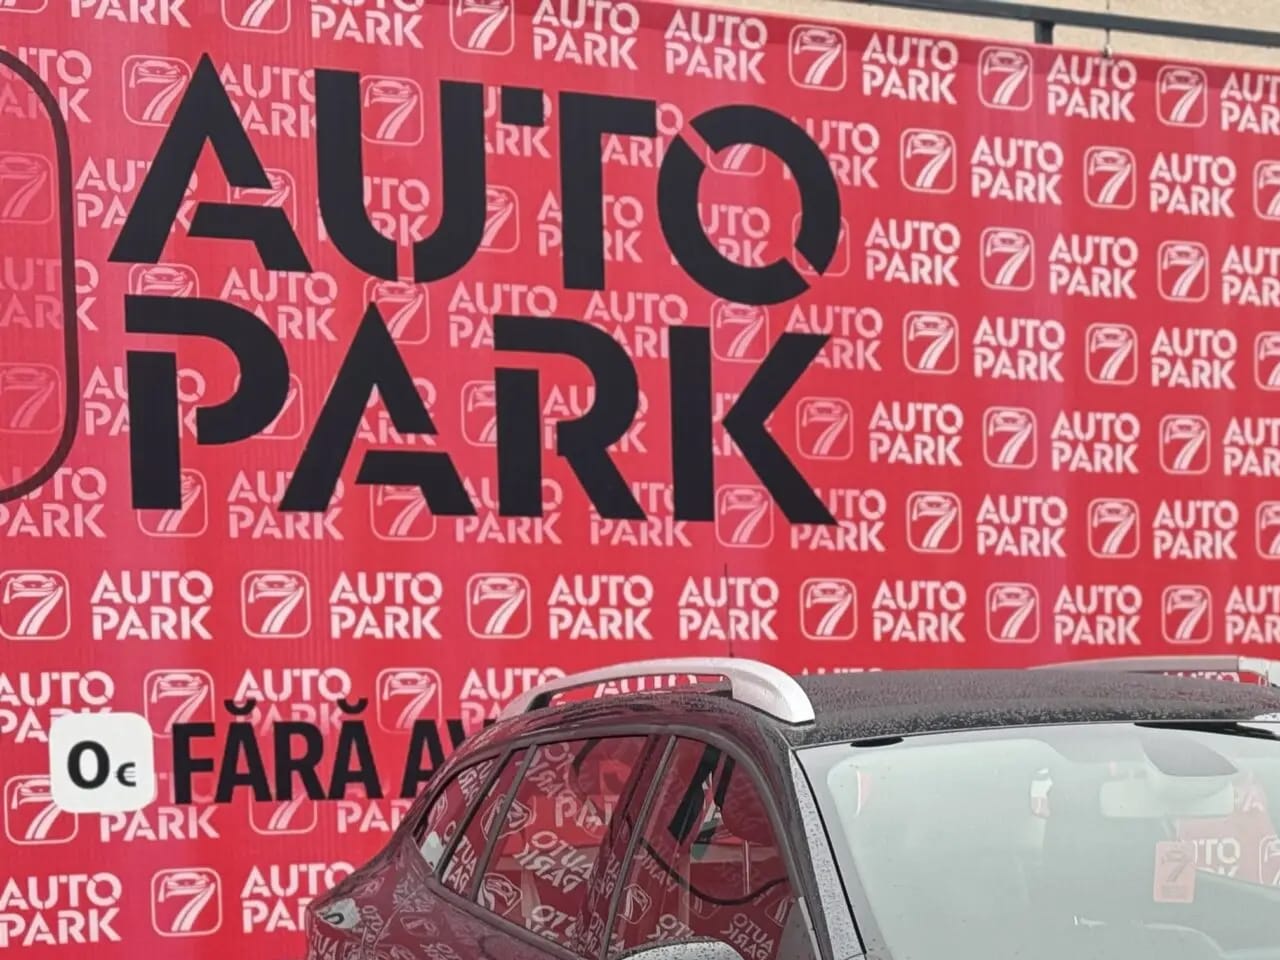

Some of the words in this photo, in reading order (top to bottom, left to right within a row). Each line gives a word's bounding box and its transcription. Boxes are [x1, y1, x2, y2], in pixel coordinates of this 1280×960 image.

[311, 4, 424, 48] PARK
[532, 0, 639, 35] AUTO
[665, 10, 767, 50] AUTO
[533, 27, 637, 70] PARK
[666, 41, 765, 83] PARK
[862, 34, 958, 71] AUTO
[863, 63, 956, 104] PARK
[1046, 55, 1136, 90] AUTO
[1047, 83, 1135, 122] PARK
[971, 136, 1064, 172] AUTO
[1149, 153, 1236, 187] AUTO
[107, 52, 842, 307] AUTO
[972, 166, 1062, 205] PARK
[1150, 181, 1234, 218] PARK
[865, 219, 961, 254] AUTO
[1048, 233, 1138, 268] AUTO
[867, 249, 959, 287] PARK
[1049, 263, 1136, 299] PARK
[220, 267, 338, 306] AUTO
[448, 281, 558, 318] AUTO
[583, 290, 689, 326] AUTO
[786, 304, 884, 339] AUTO
[450, 315, 494, 349] PA
[973, 317, 1065, 351] AUTO
[1151, 328, 1237, 359] AUTO
[974, 346, 1064, 382] PARK
[1152, 357, 1235, 389] PARK
[124, 294, 838, 525] PARK
[869, 402, 963, 435] AUTO
[1051, 411, 1140, 443] AUTO
[870, 432, 961, 466] PARK
[1052, 440, 1138, 473] PARK
[229, 504, 345, 541] PARK
[456, 512, 563, 544] PARK
[976, 495, 1068, 527] AUTO
[1153, 500, 1239, 529] AUTO
[590, 513, 692, 547] PARK
[790, 521, 886, 552] PARK
[977, 524, 1066, 557] PARK
[1154, 529, 1236, 559] PARK
[91, 571, 213, 604] AUTO
[329, 572, 443, 605] AUTO
[548, 575, 653, 607] AUTO
[678, 577, 779, 608] AUTO
[872, 581, 966, 611] AUTO
[1054, 585, 1142, 614] AUTO
[92, 606, 212, 640] PARK
[331, 605, 441, 639] PARK
[550, 607, 652, 640] PARK
[679, 608, 777, 640] PARK
[874, 610, 964, 642] PARK
[1054, 614, 1140, 644] PARK
[234, 667, 352, 702] AUTO
[172, 696, 384, 804] FĂRĂ
[100, 806, 220, 842] PARK
[0, 872, 122, 911] AUTO
[0, 908, 121, 947] PARK
